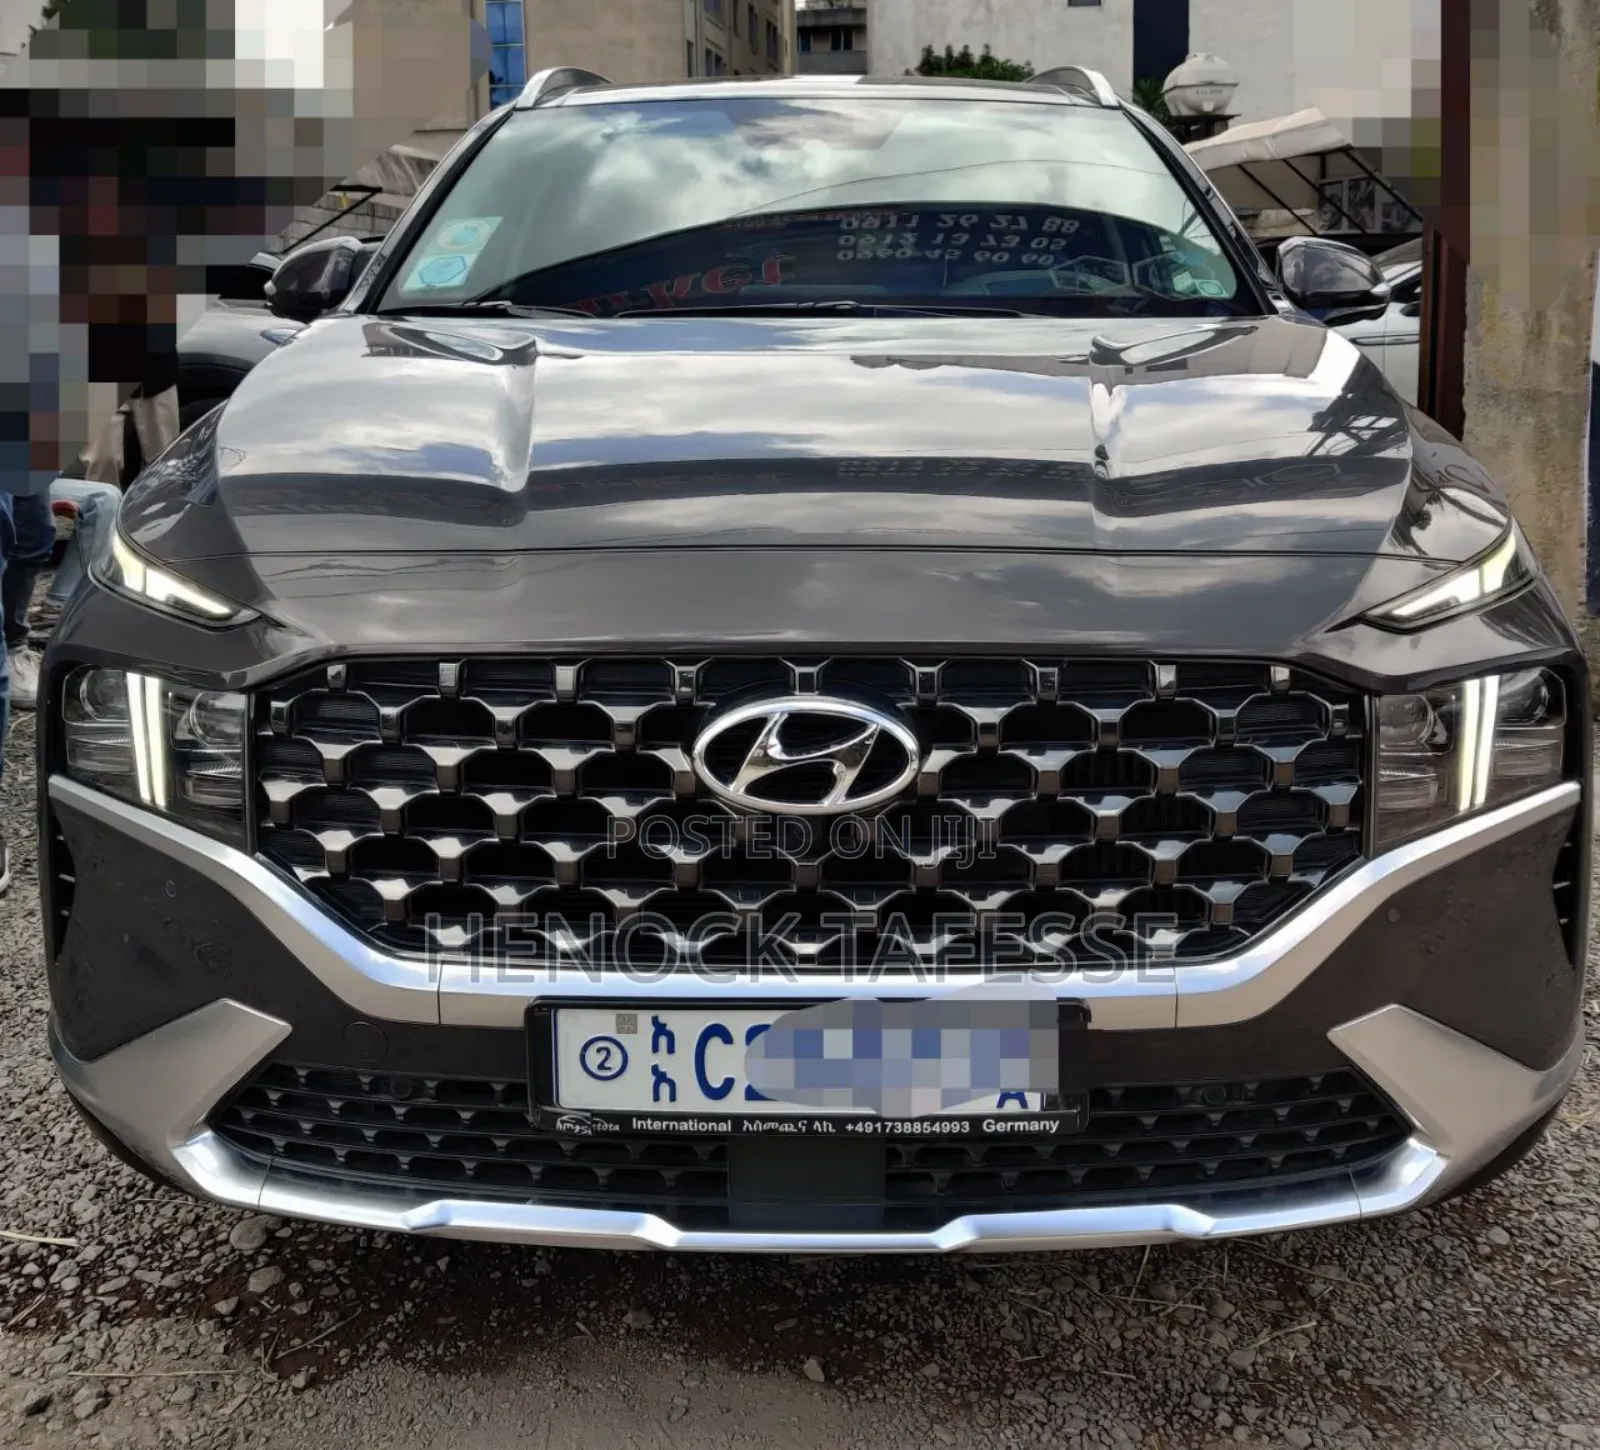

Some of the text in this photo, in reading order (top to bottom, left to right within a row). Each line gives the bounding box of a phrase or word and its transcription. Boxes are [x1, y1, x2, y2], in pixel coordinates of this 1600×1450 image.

[632, 1117, 732, 1133] International
[845, 1120, 970, 1134] +491738854993
[982, 1118, 1060, 1134] Germany
